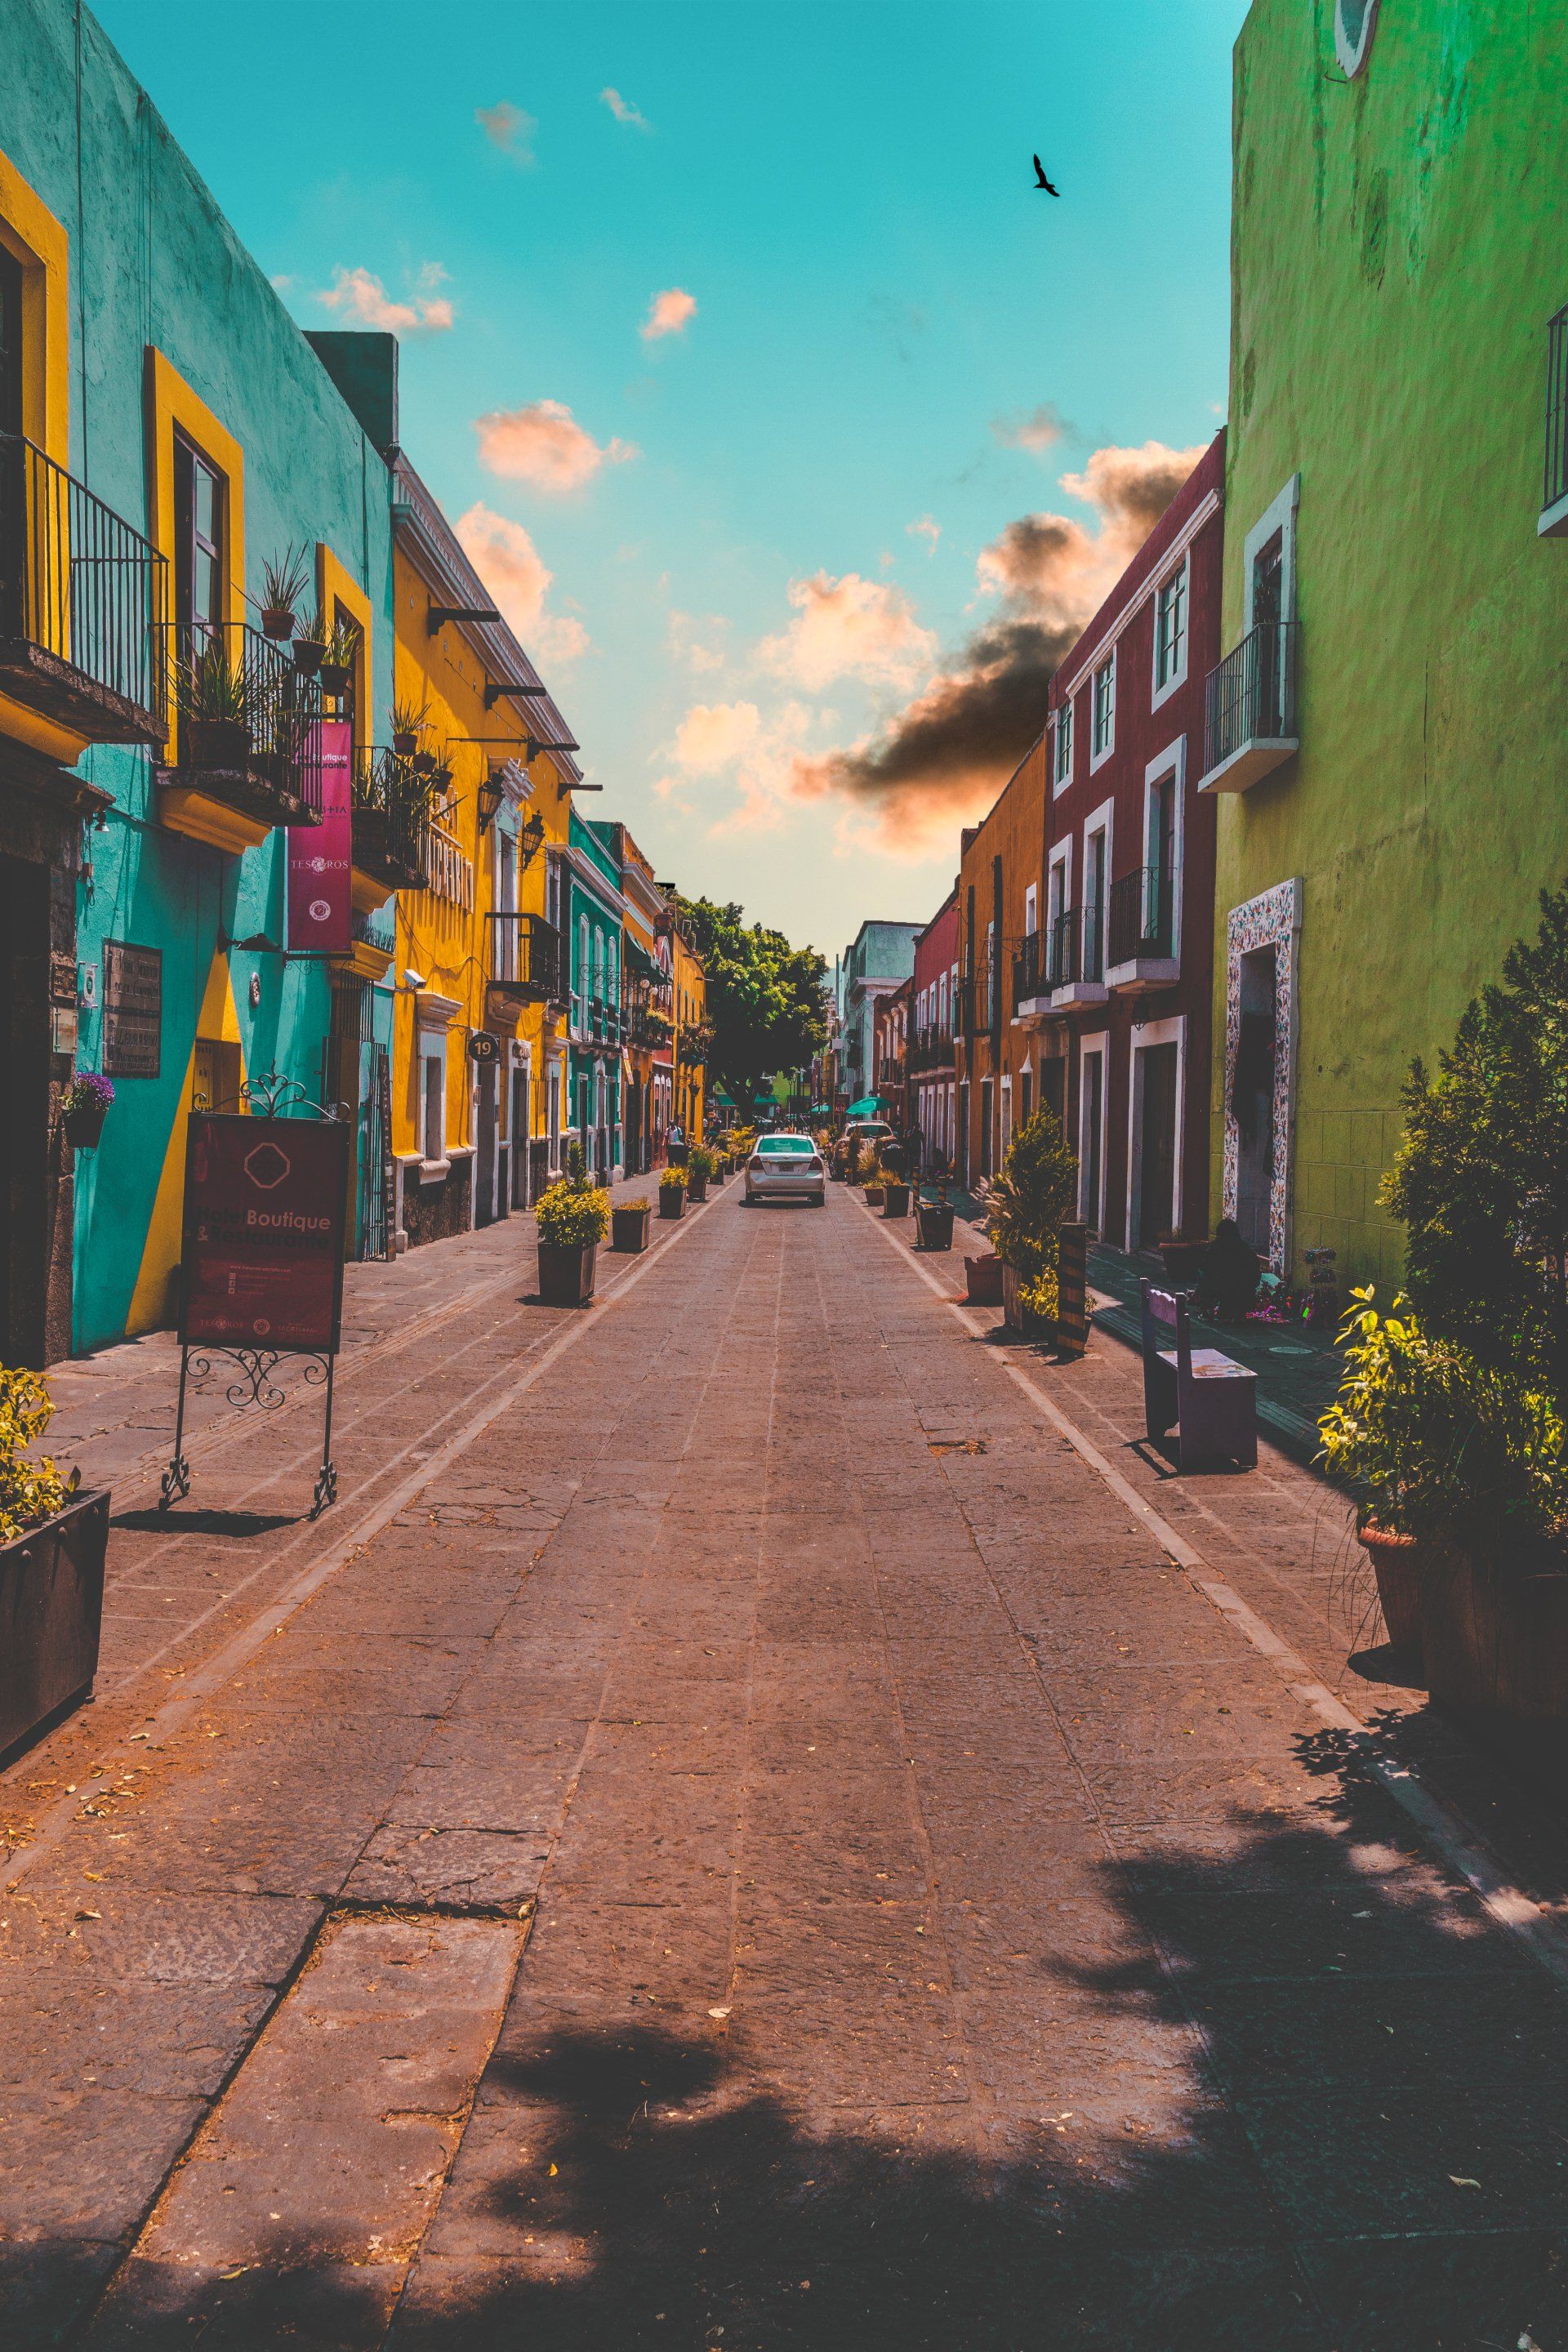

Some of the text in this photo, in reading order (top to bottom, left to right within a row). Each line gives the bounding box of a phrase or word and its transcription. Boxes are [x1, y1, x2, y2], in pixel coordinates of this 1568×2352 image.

[311, 753, 348, 762] Butique
[474, 1041, 492, 1055] 19
[197, 1205, 331, 1232] Hotel Boutique
[197, 1225, 329, 1248] & Restaurante
